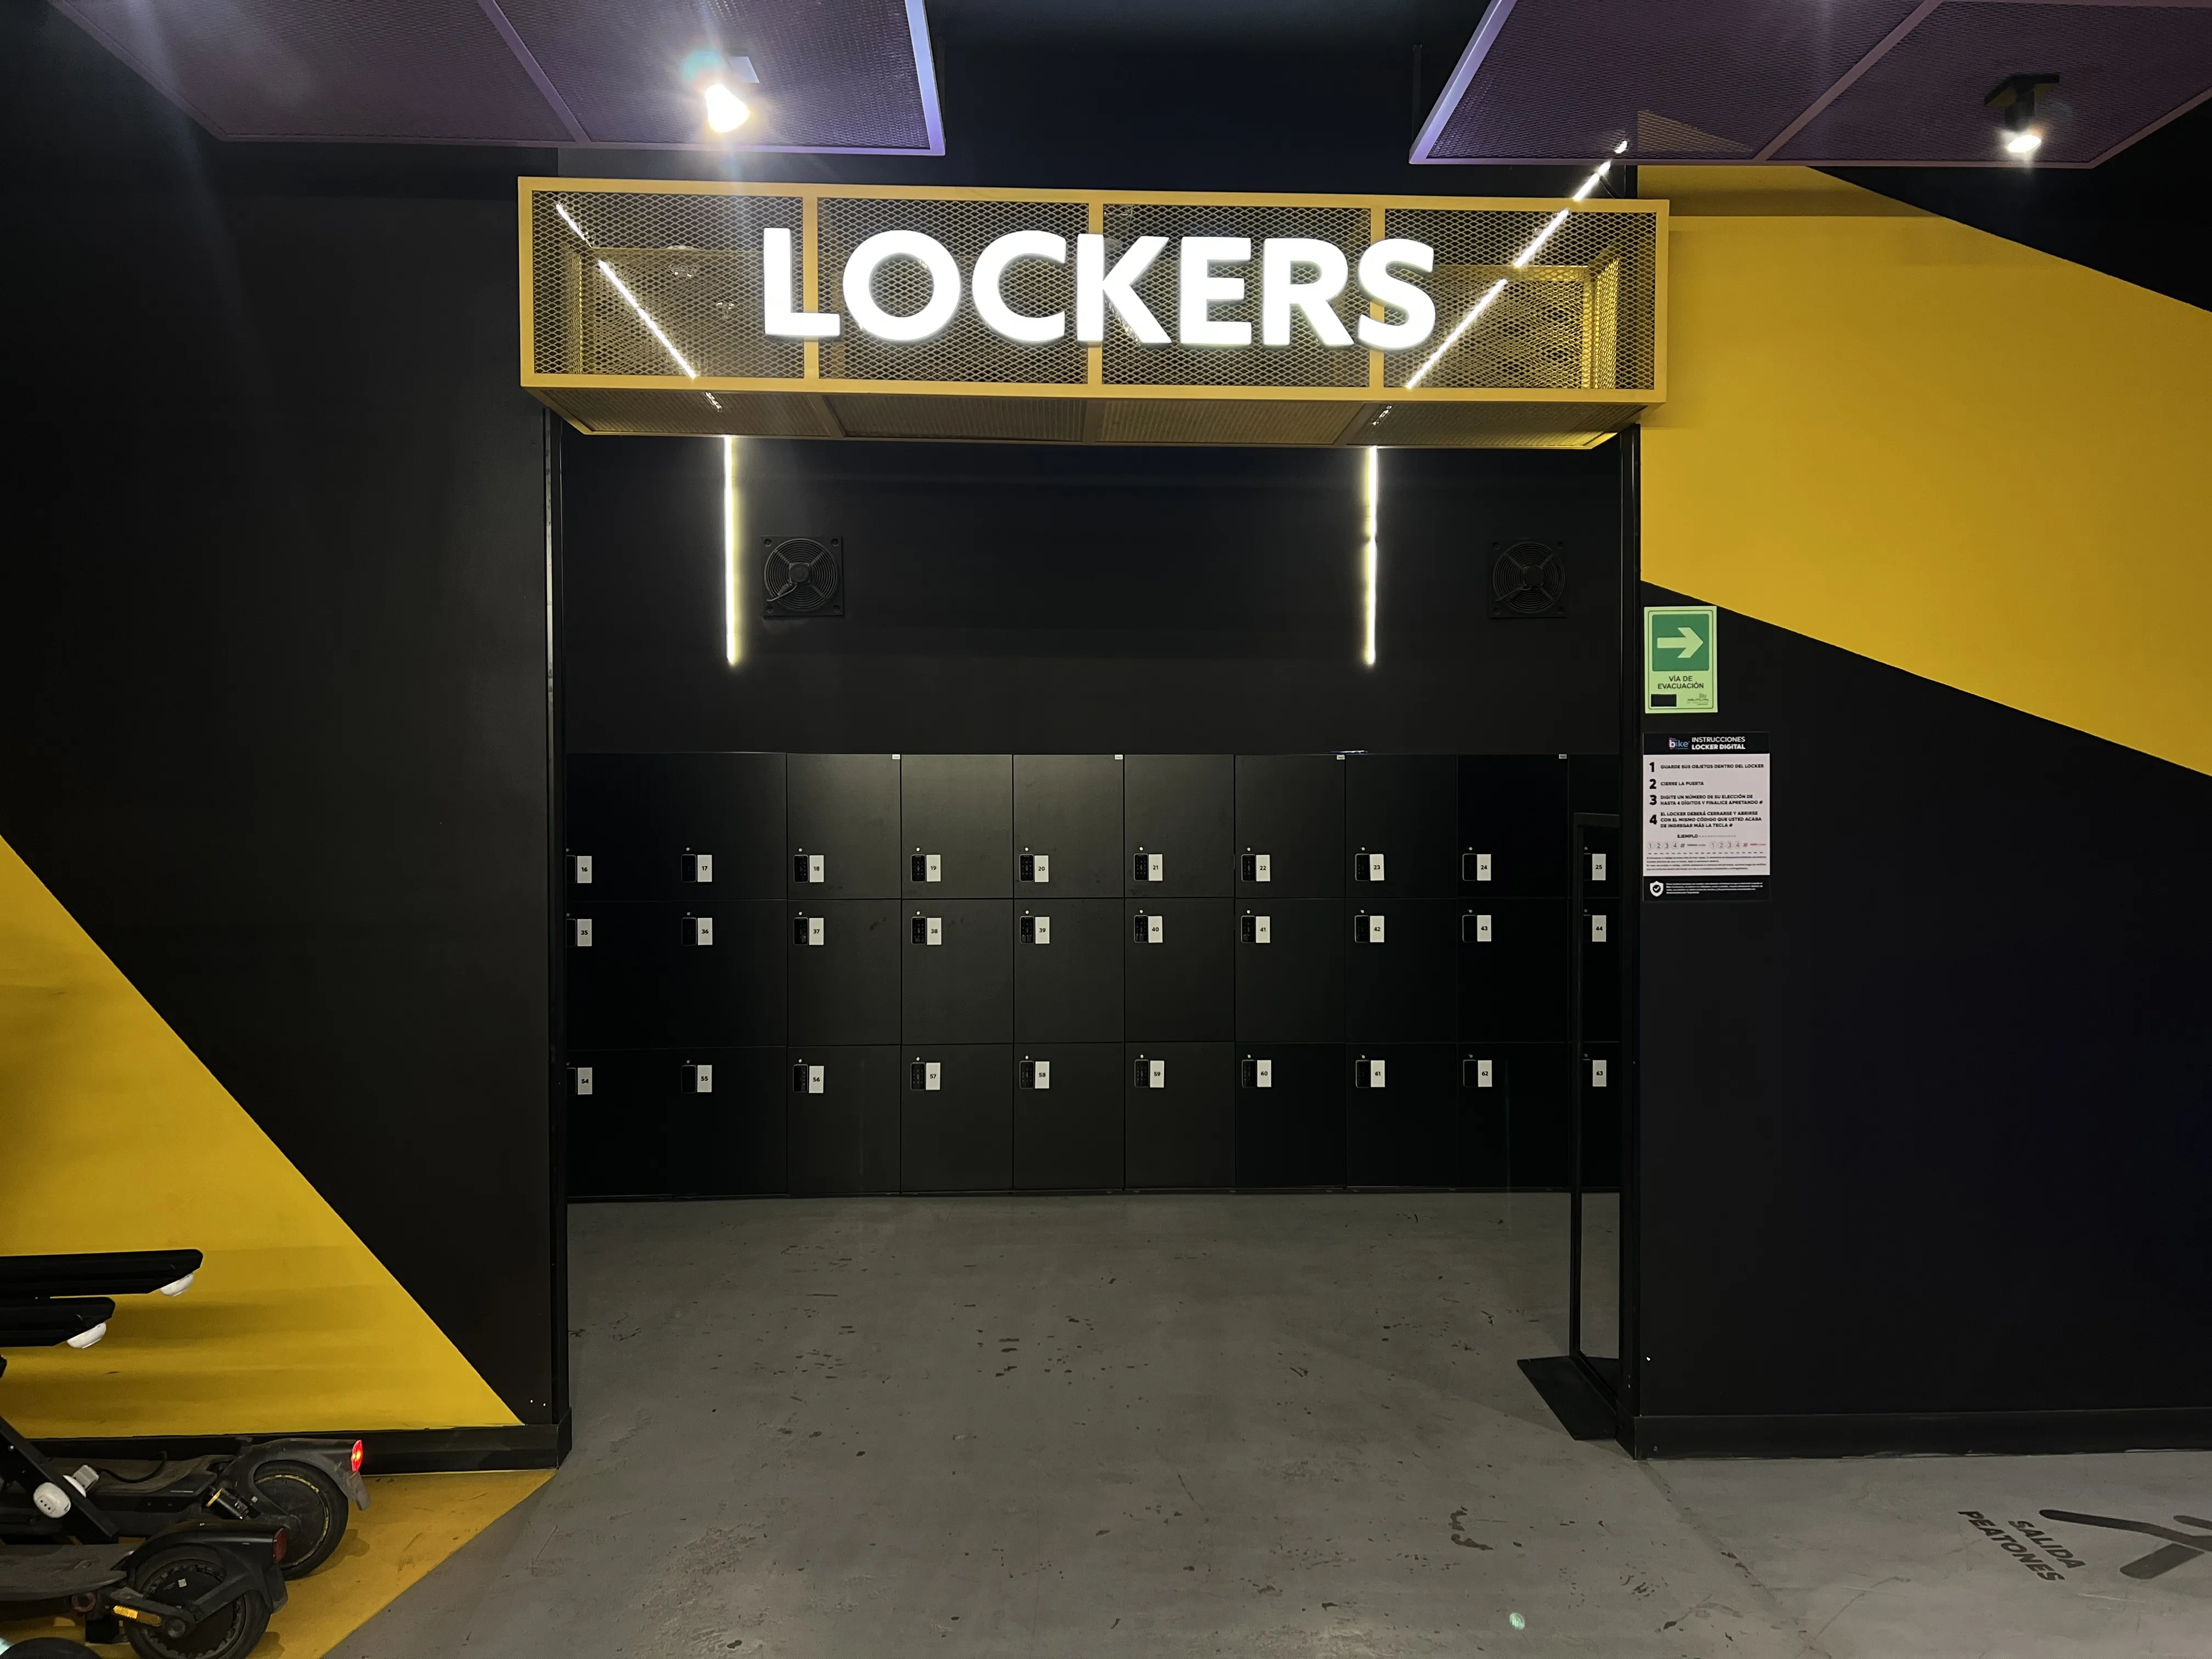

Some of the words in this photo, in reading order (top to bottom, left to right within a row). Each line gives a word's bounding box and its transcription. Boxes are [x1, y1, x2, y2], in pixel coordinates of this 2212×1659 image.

[763, 228, 1436, 349] LOCKERS
[1649, 762, 1655, 772] 1
[1650, 779, 1656, 789] 2
[1649, 795, 1657, 805] 3
[1649, 815, 1657, 825] 4
[1957, 1511, 2065, 1581] PEATONES
[2008, 1520, 2086, 1568] SALIDA
